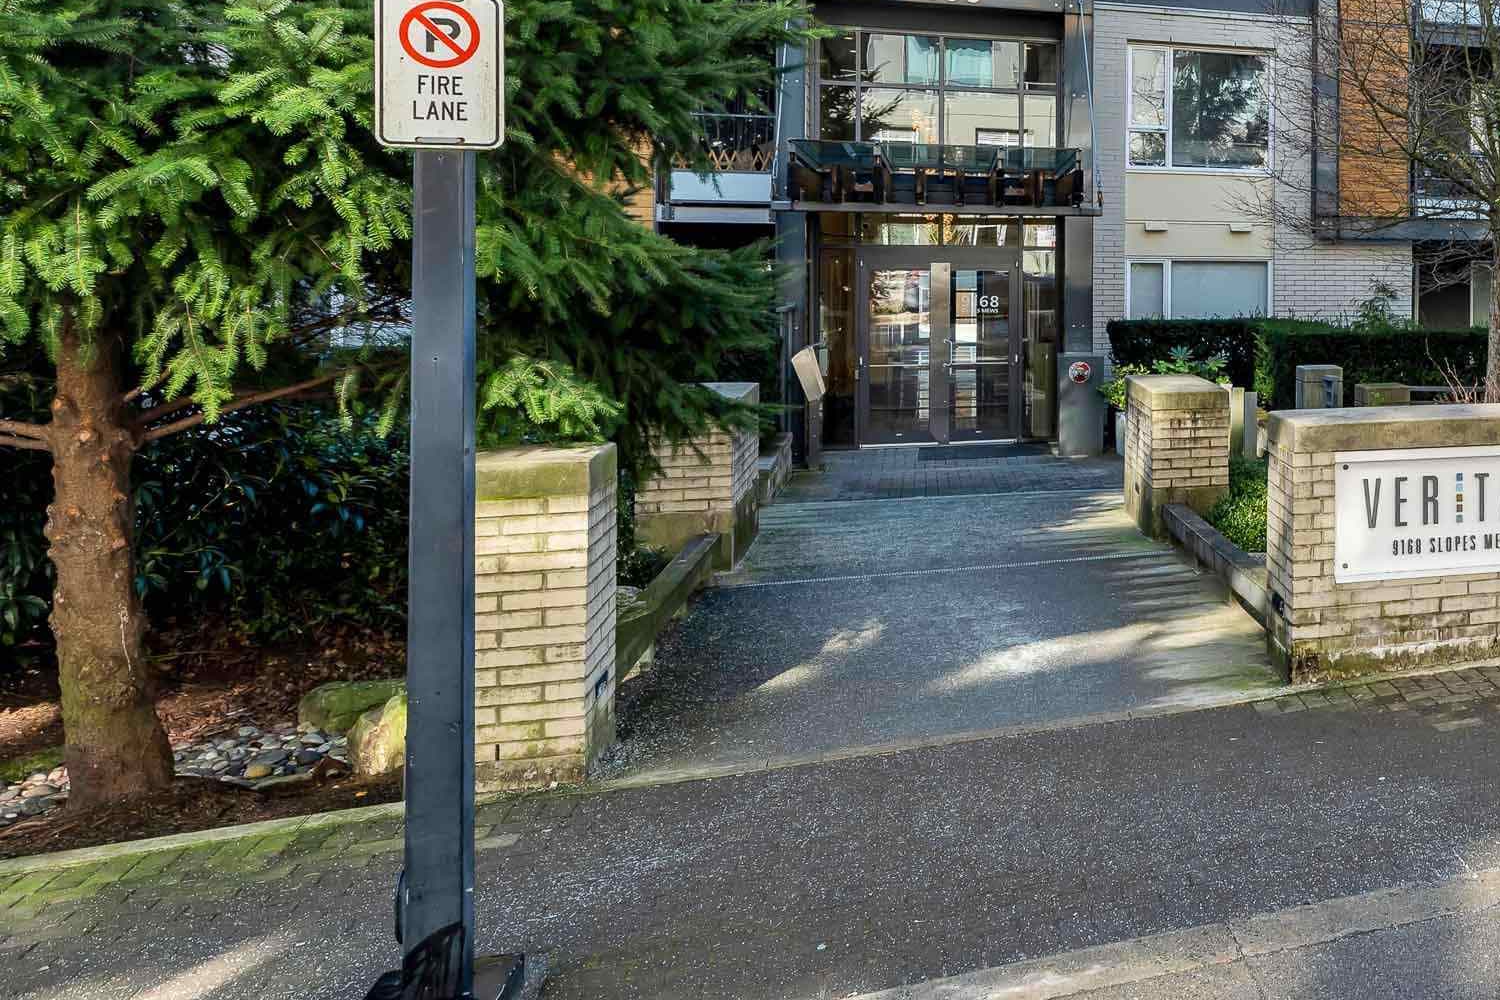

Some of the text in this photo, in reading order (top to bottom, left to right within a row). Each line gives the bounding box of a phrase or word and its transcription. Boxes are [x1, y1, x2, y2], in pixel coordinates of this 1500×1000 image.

[418, 74, 463, 96] FIRE
[413, 100, 468, 121] LANE
[1391, 536, 1422, 556] 9168
[1429, 534, 1477, 553] SLOPES
